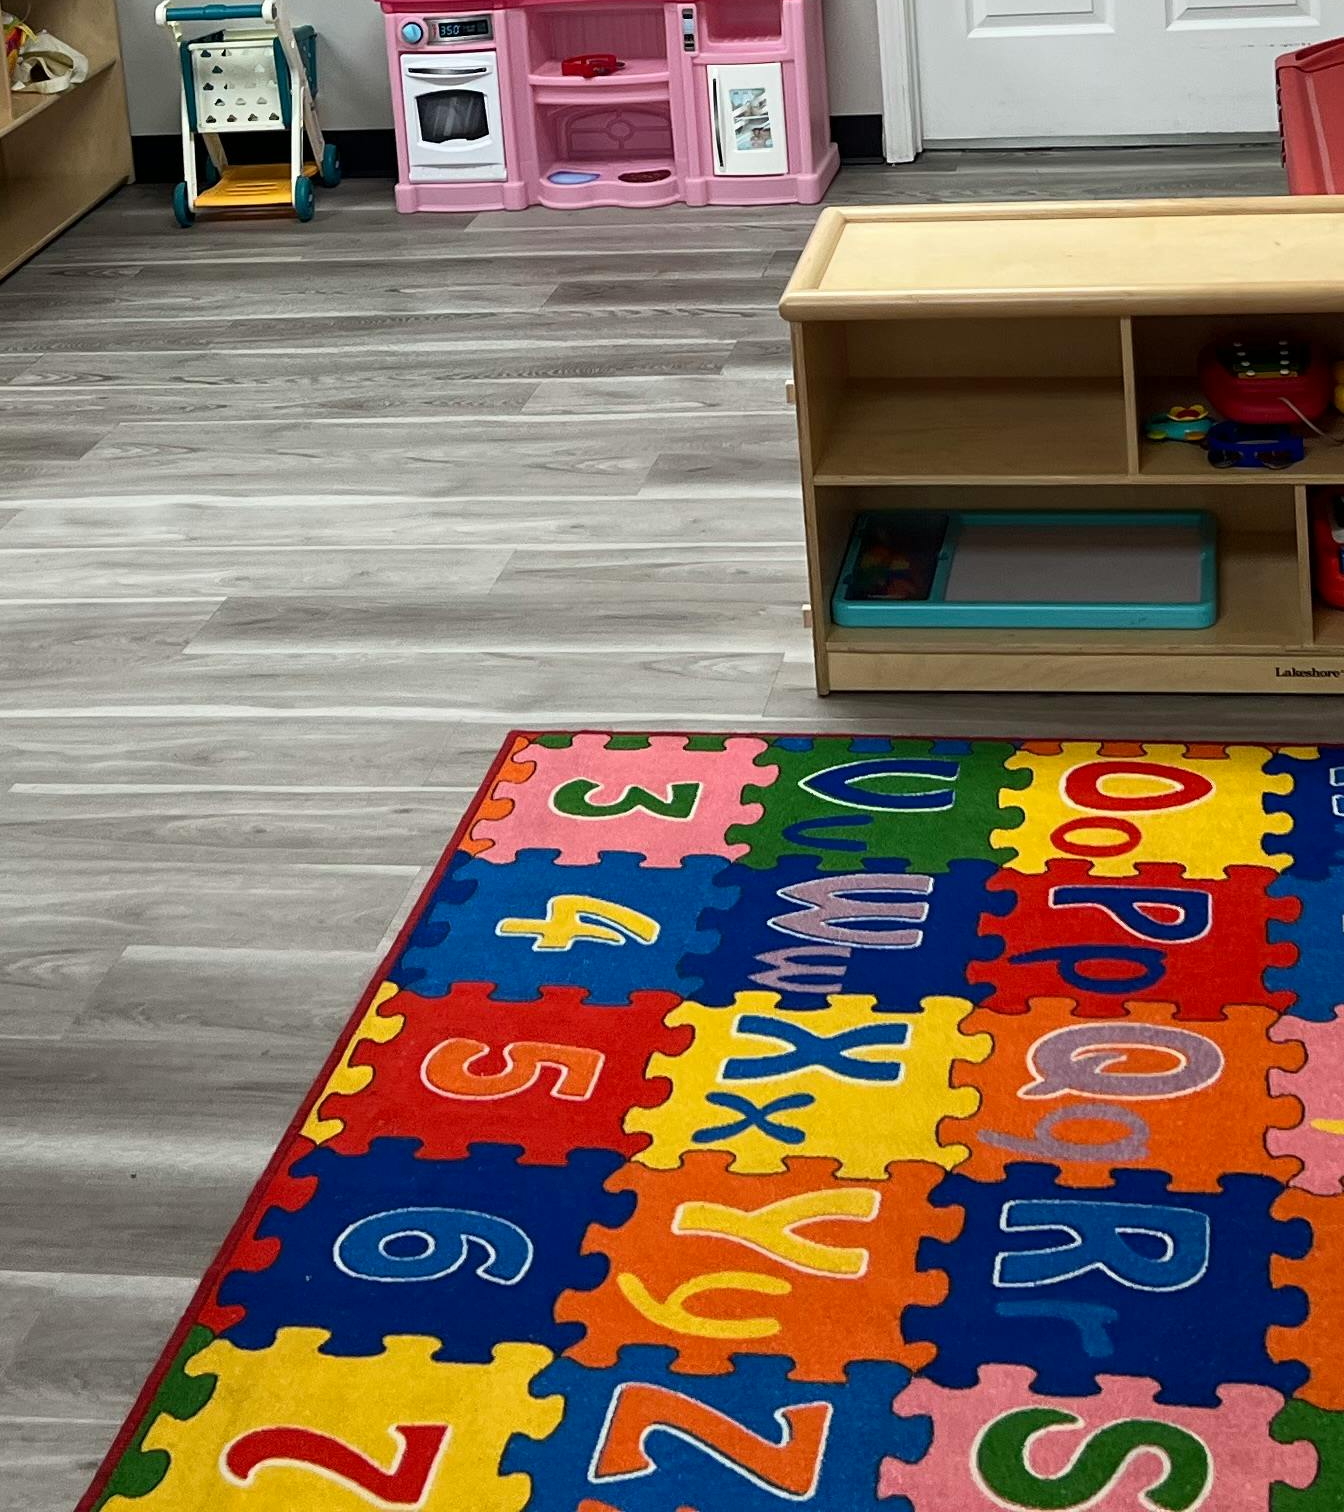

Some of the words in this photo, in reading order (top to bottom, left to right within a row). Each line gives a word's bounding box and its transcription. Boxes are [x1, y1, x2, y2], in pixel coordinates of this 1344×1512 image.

[1275, 666, 1342, 679] Lakeshore
[551, 776, 701, 822] 3
[495, 893, 661, 953] 4
[419, 1035, 605, 1102] 5
[332, 1204, 534, 1287] 6
[218, 1422, 452, 1511] 7
